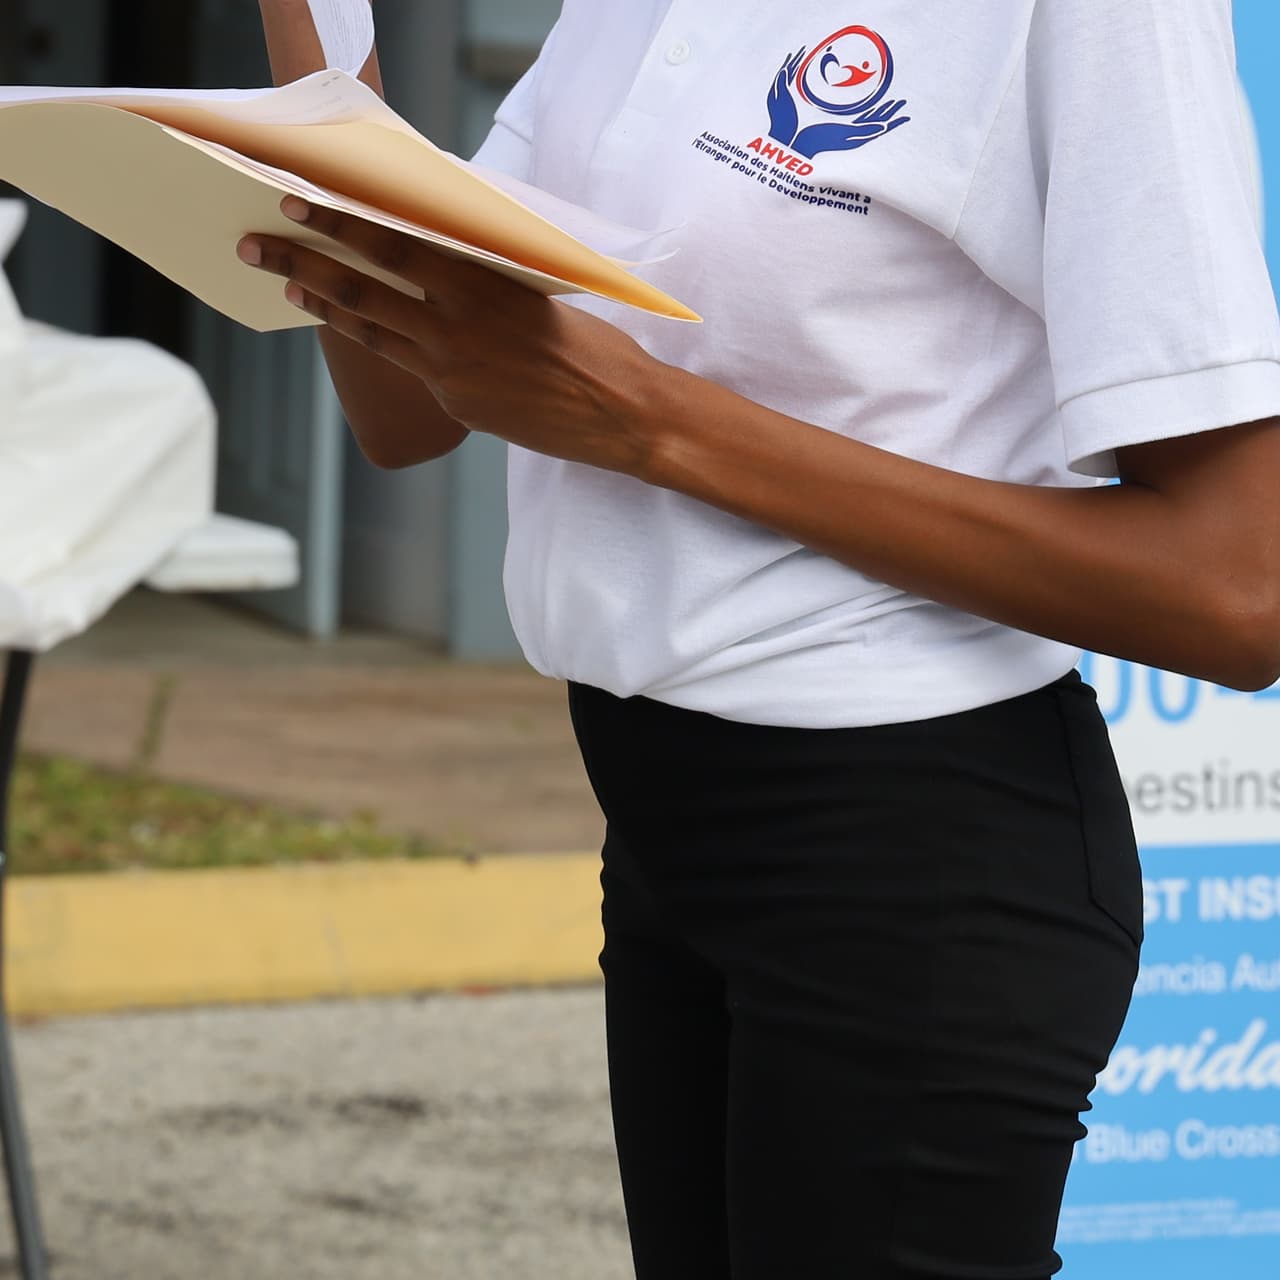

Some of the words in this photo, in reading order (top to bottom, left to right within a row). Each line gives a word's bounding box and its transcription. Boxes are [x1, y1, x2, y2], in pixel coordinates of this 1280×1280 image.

[699, 130, 750, 161] Association
[750, 157, 769, 172] des
[746, 137, 814, 177] AHVED
[731, 161, 757, 178] pour
[757, 172, 768, 184] le
[768, 178, 870, 216] Developpement
[1085, 1122, 1170, 1164] Blue
